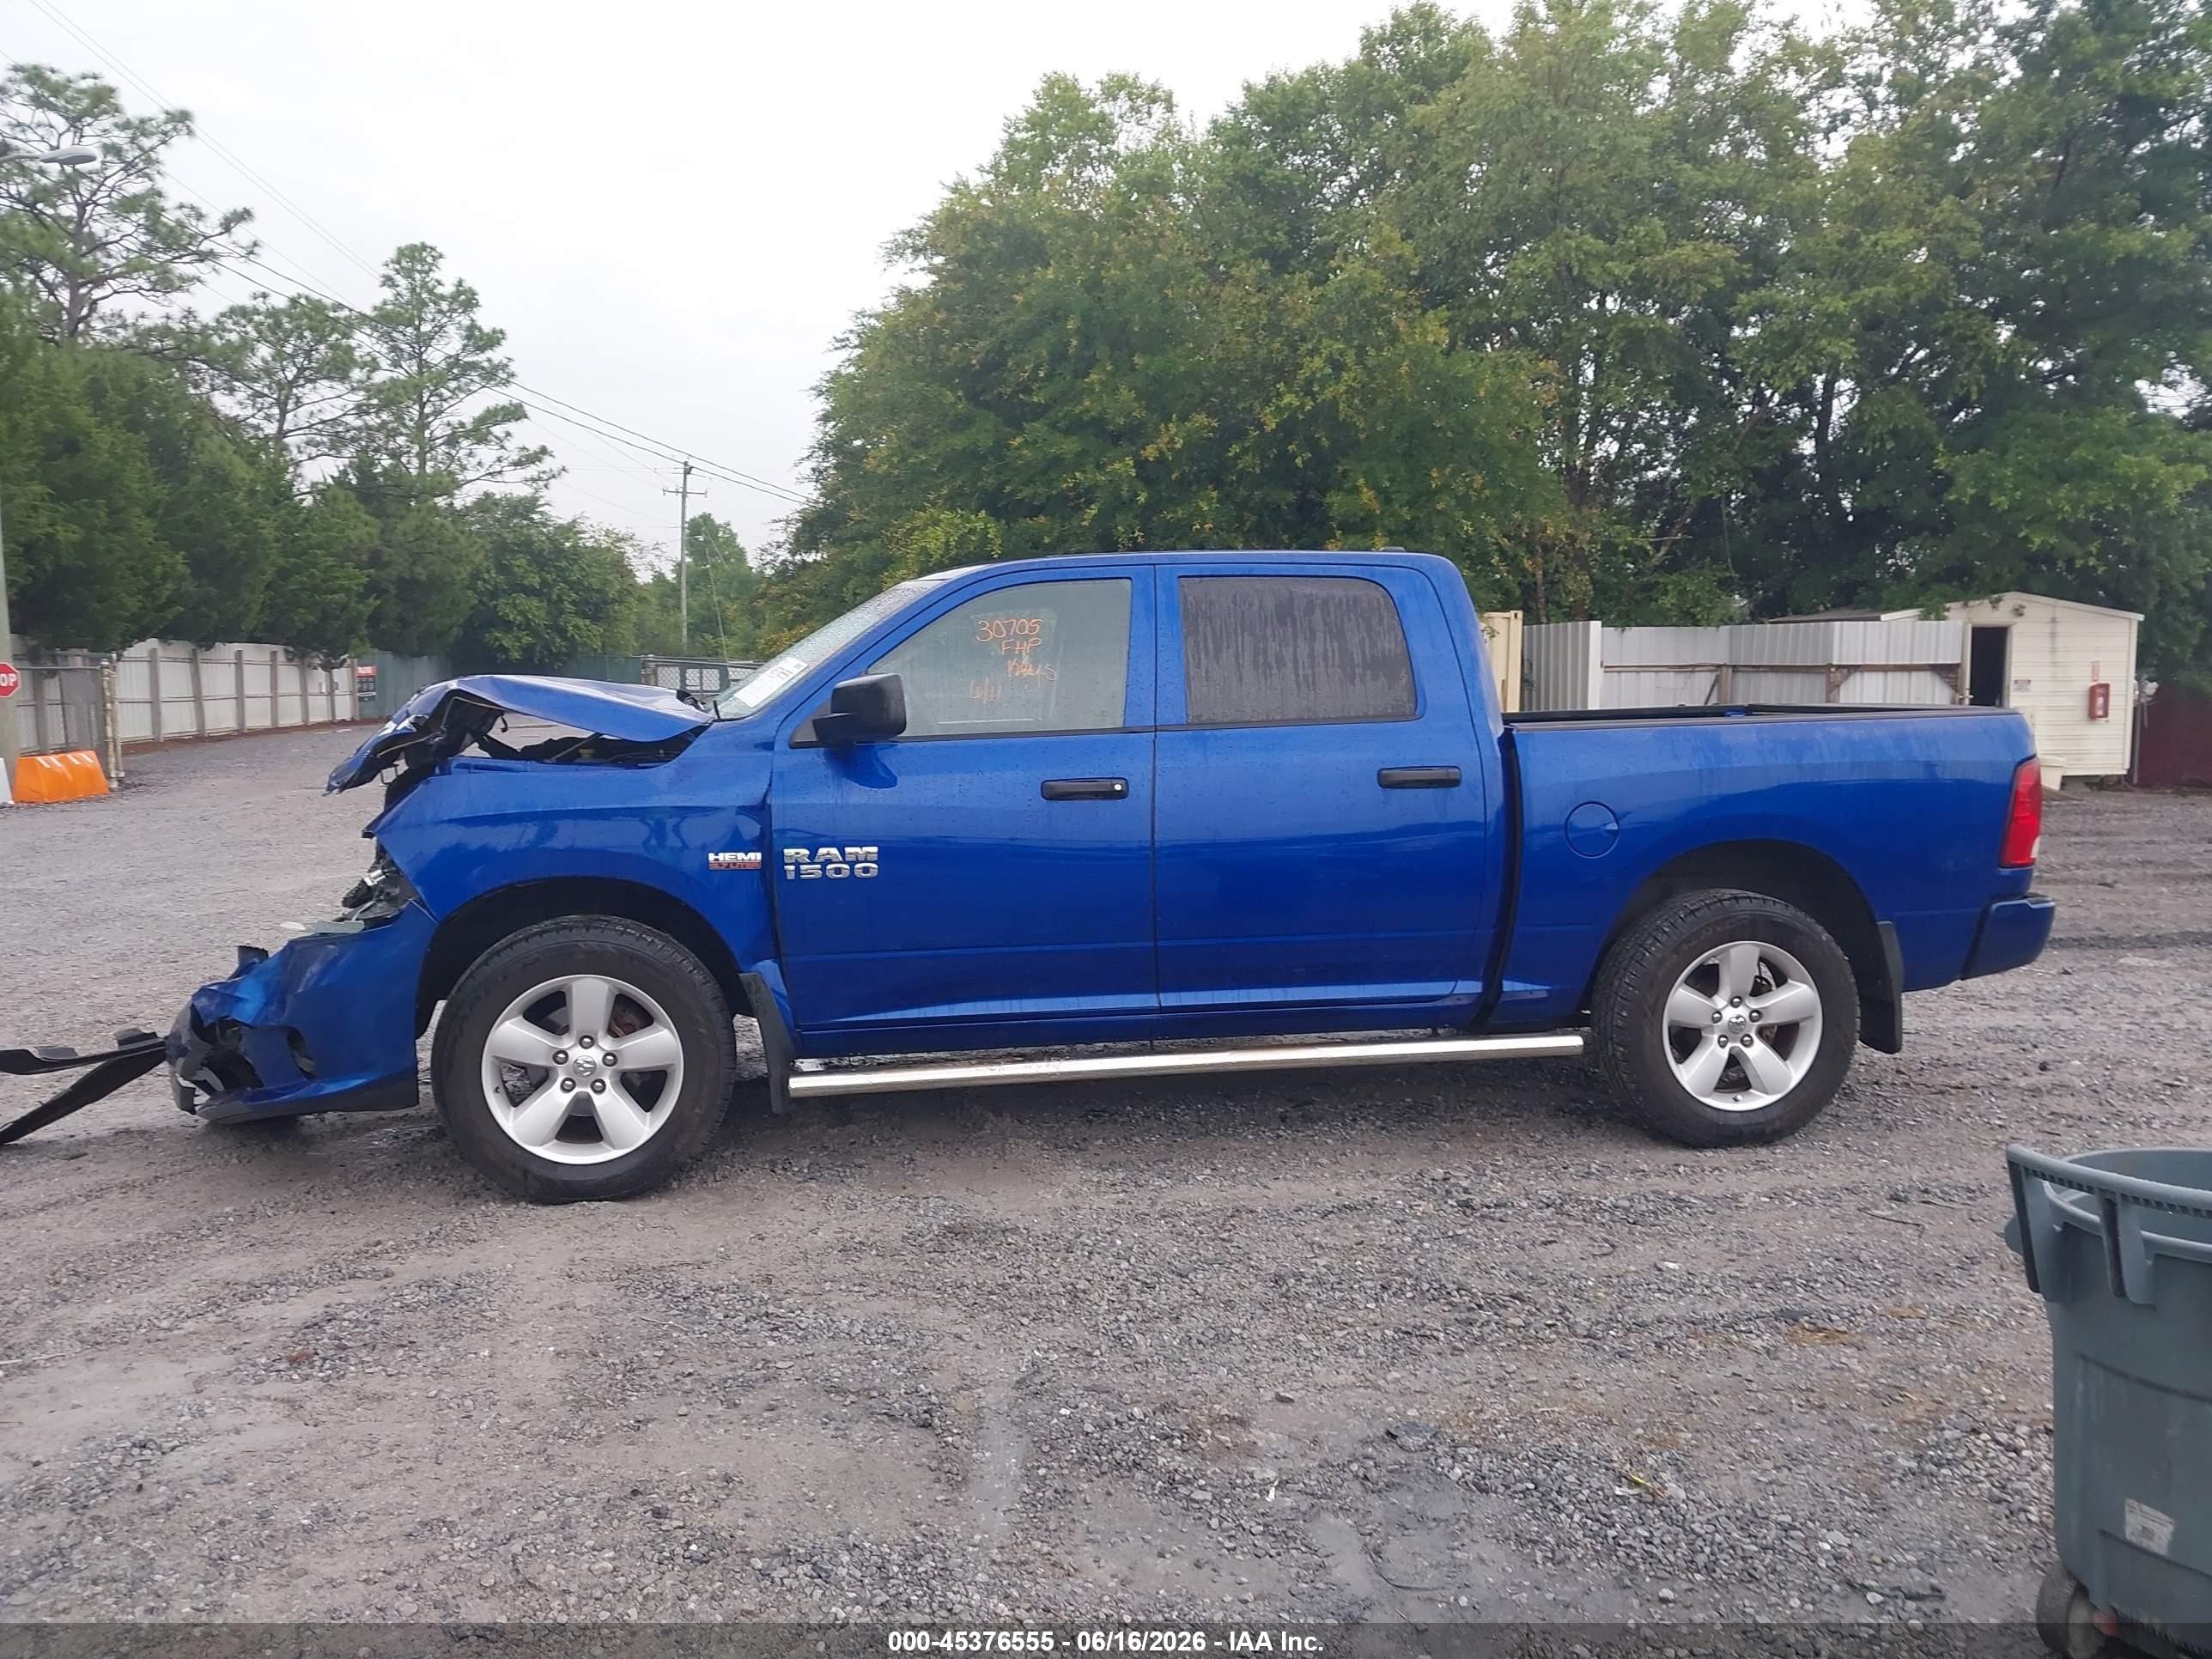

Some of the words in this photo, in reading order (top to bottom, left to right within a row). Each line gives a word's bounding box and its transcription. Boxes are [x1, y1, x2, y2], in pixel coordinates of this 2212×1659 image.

[975, 618, 1043, 642] 30705
[708, 852, 763, 861] HEMI
[783, 847, 878, 863] RAM
[783, 863, 879, 880] 1500
